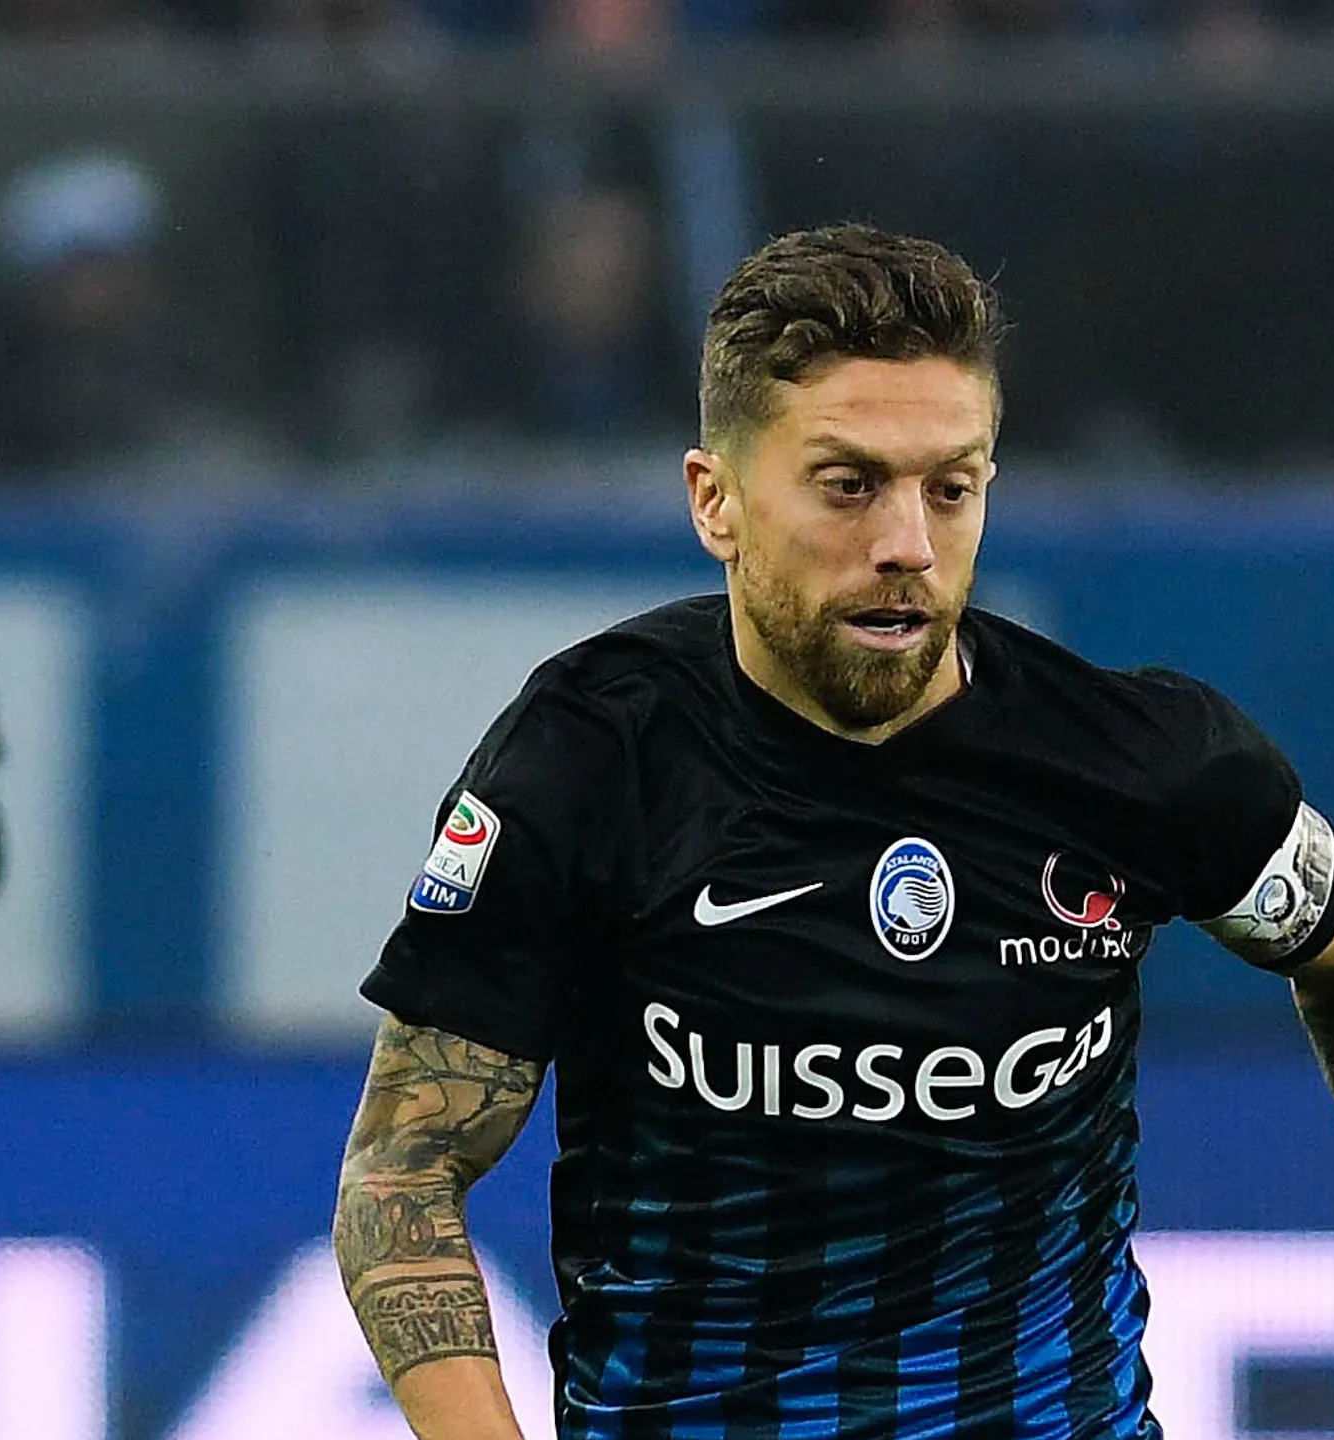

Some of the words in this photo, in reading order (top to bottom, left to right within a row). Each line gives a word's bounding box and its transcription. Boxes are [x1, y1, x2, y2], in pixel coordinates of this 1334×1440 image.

[885, 854, 942, 874] ATALANTA
[420, 876, 458, 908] TIM
[894, 931, 929, 945] 1907
